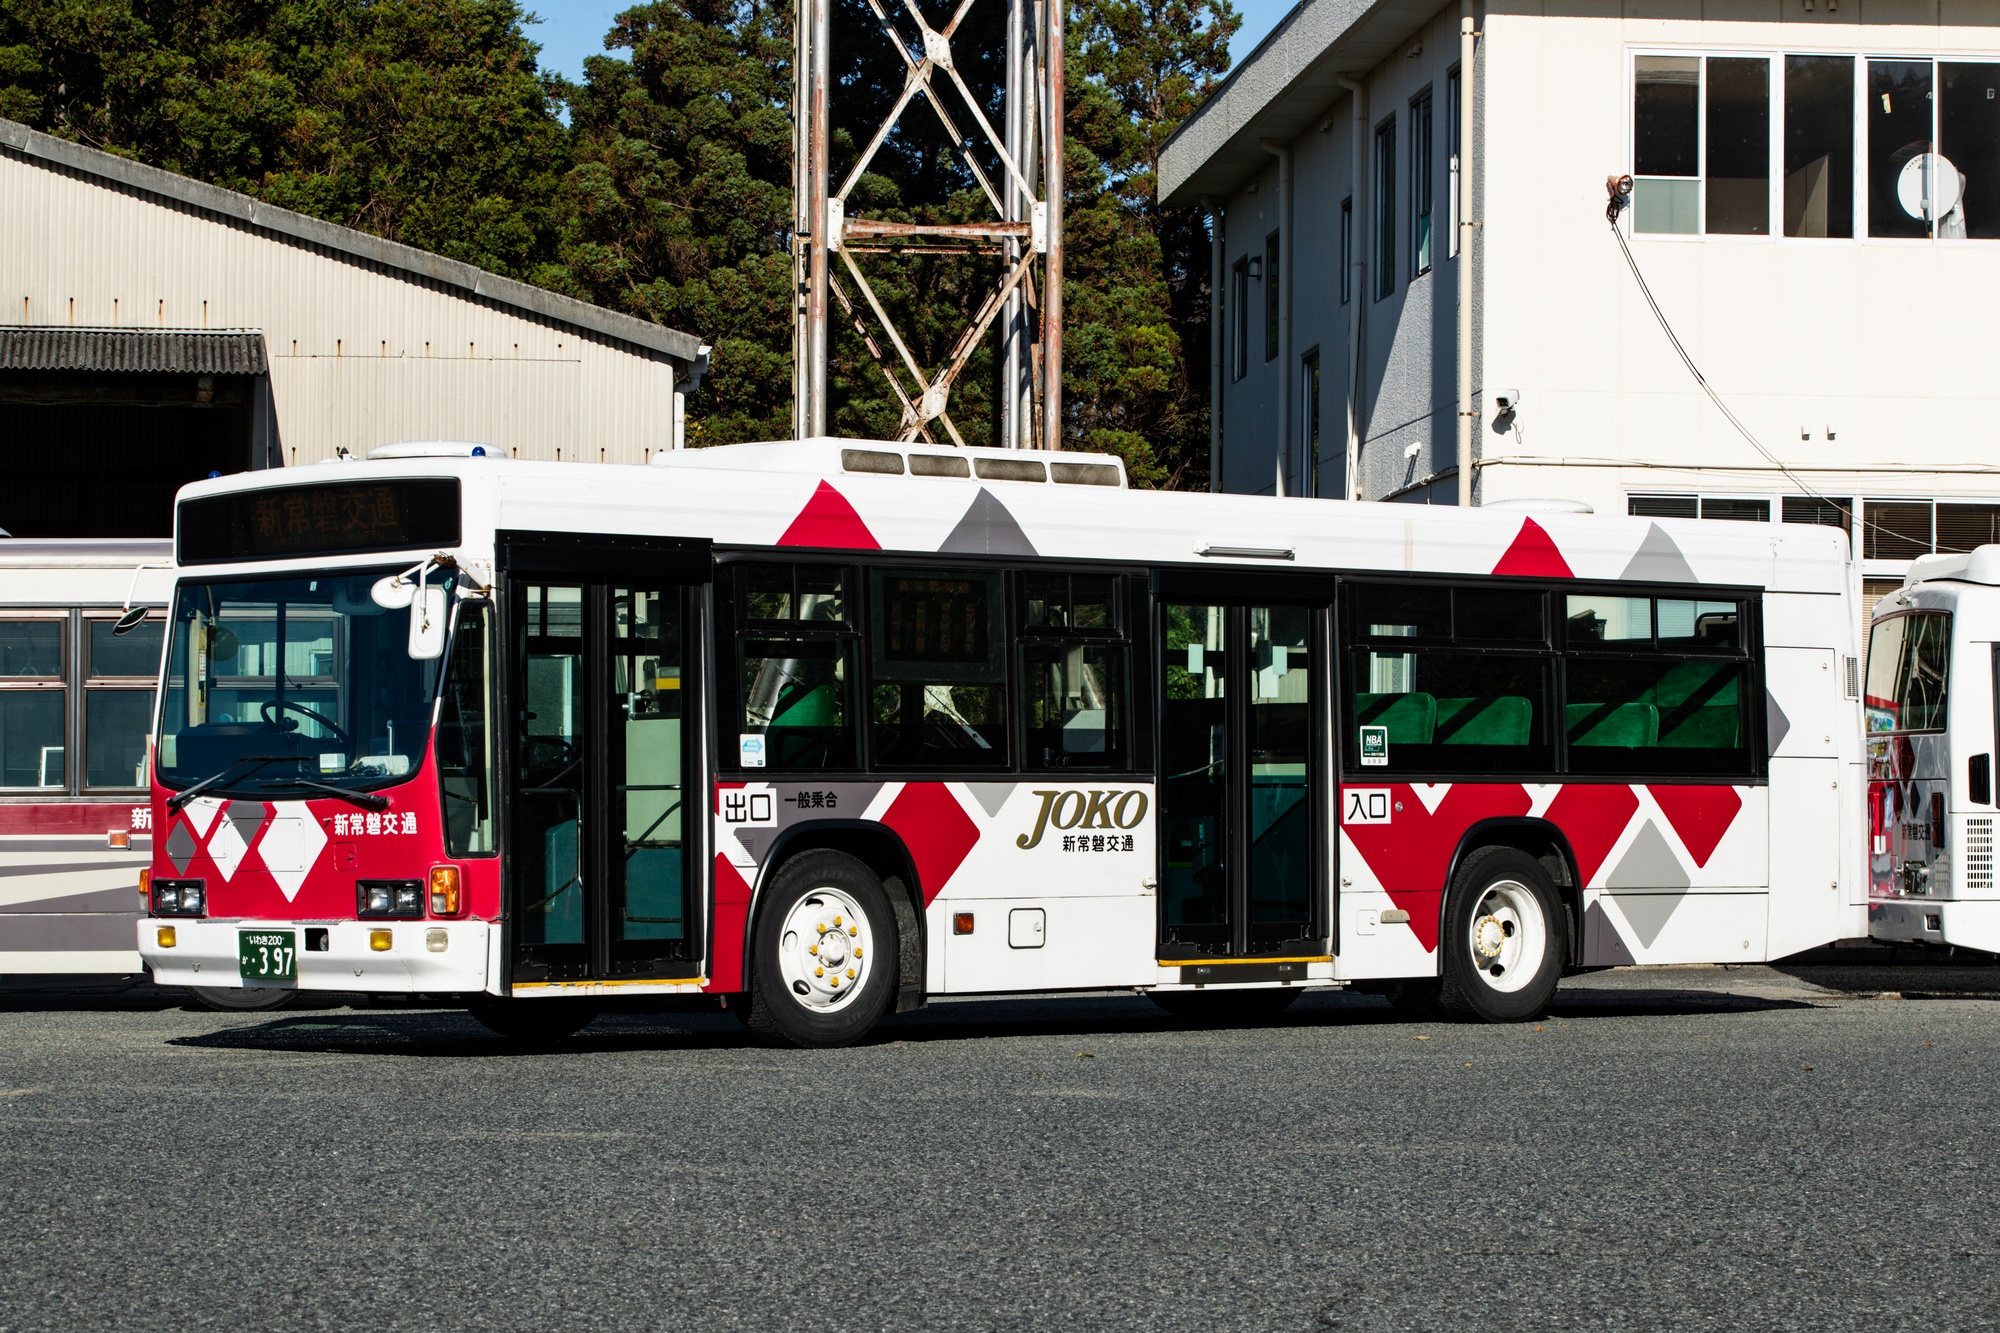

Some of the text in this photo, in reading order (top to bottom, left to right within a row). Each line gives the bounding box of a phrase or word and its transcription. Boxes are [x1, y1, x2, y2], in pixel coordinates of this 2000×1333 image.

[255, 486, 397, 537] 新常磐交通
[1366, 735, 1382, 745] NBA
[725, 792, 771, 823] 出口
[784, 791, 838, 809] 一般乗合
[1348, 793, 1386, 820] 入口
[334, 812, 418, 836] 新常磐交通
[1016, 790, 1149, 850] JOKO
[1062, 834, 1134, 852] 新常磐交通
